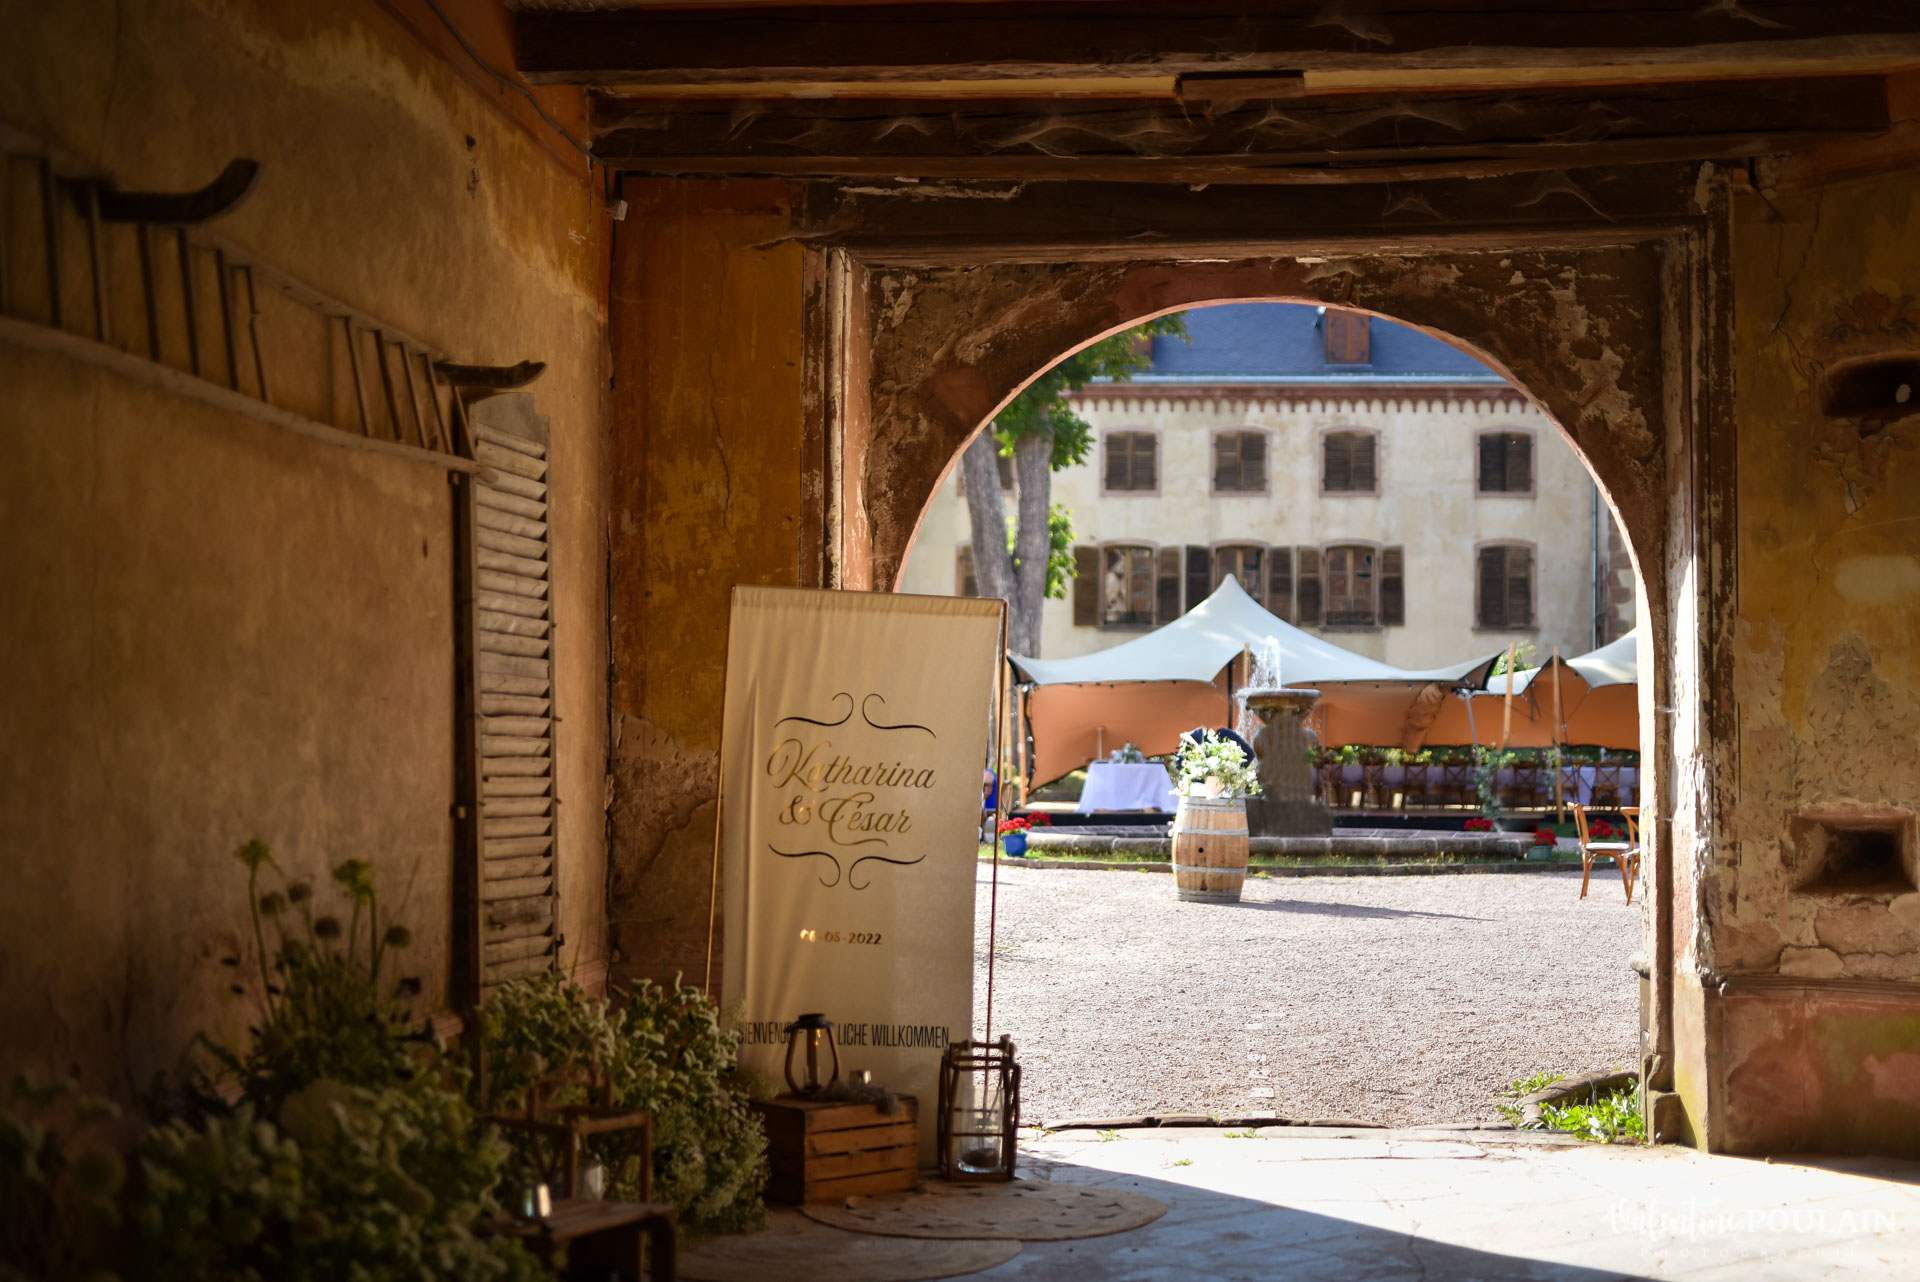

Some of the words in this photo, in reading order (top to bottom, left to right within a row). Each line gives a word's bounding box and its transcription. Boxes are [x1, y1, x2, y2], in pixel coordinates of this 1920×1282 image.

[766, 738, 937, 793] Katharina
[778, 795, 812, 826] &
[818, 791, 913, 847] César
[871, 1023, 950, 1049] WILLKOMMEN
